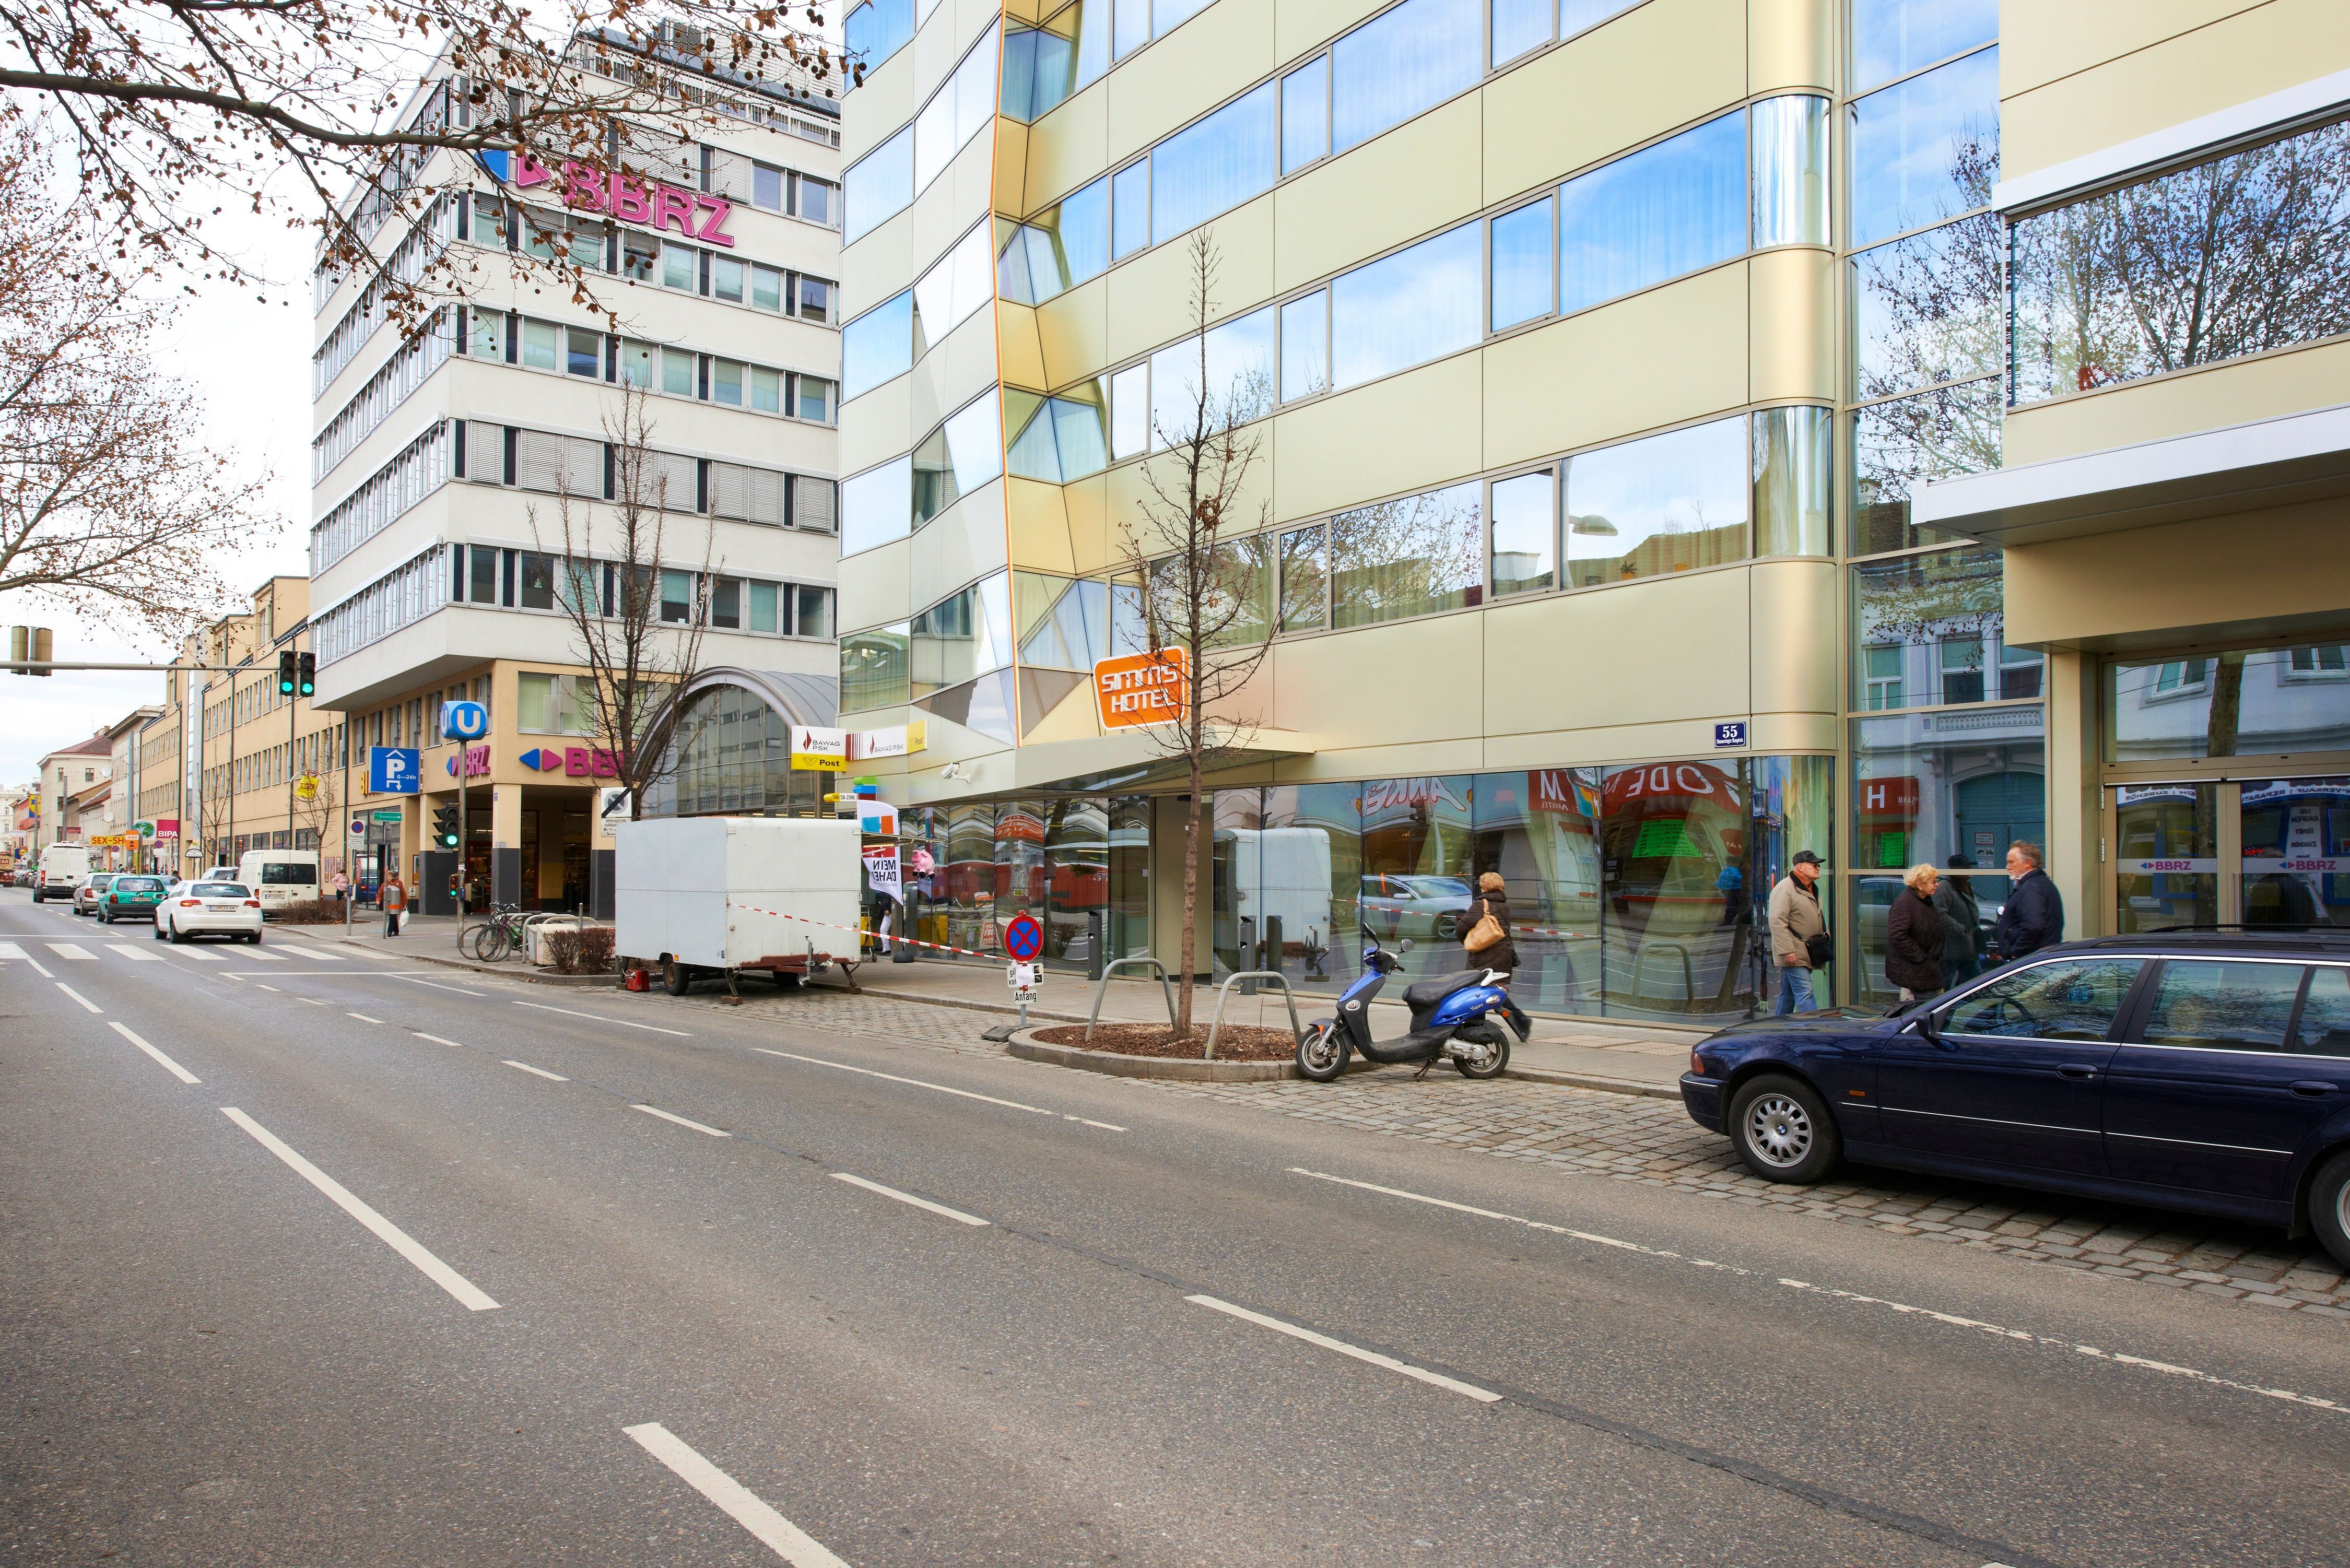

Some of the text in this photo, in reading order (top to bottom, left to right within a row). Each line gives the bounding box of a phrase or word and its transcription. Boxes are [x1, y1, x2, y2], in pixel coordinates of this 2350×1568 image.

[564, 158, 734, 248] BBRZ
[1111, 688, 1178, 713] HOTEL
[457, 709, 480, 734] U
[1723, 725, 1737, 738] 55
[915, 737, 923, 746] Post
[386, 759, 406, 779] P
[458, 745, 490, 777] BRZ
[566, 747, 636, 777] BB
[2155, 861, 2191, 870] BBRZ
[2296, 860, 2337, 870] BBRZ
[1015, 991, 1037, 1003] Anfang
